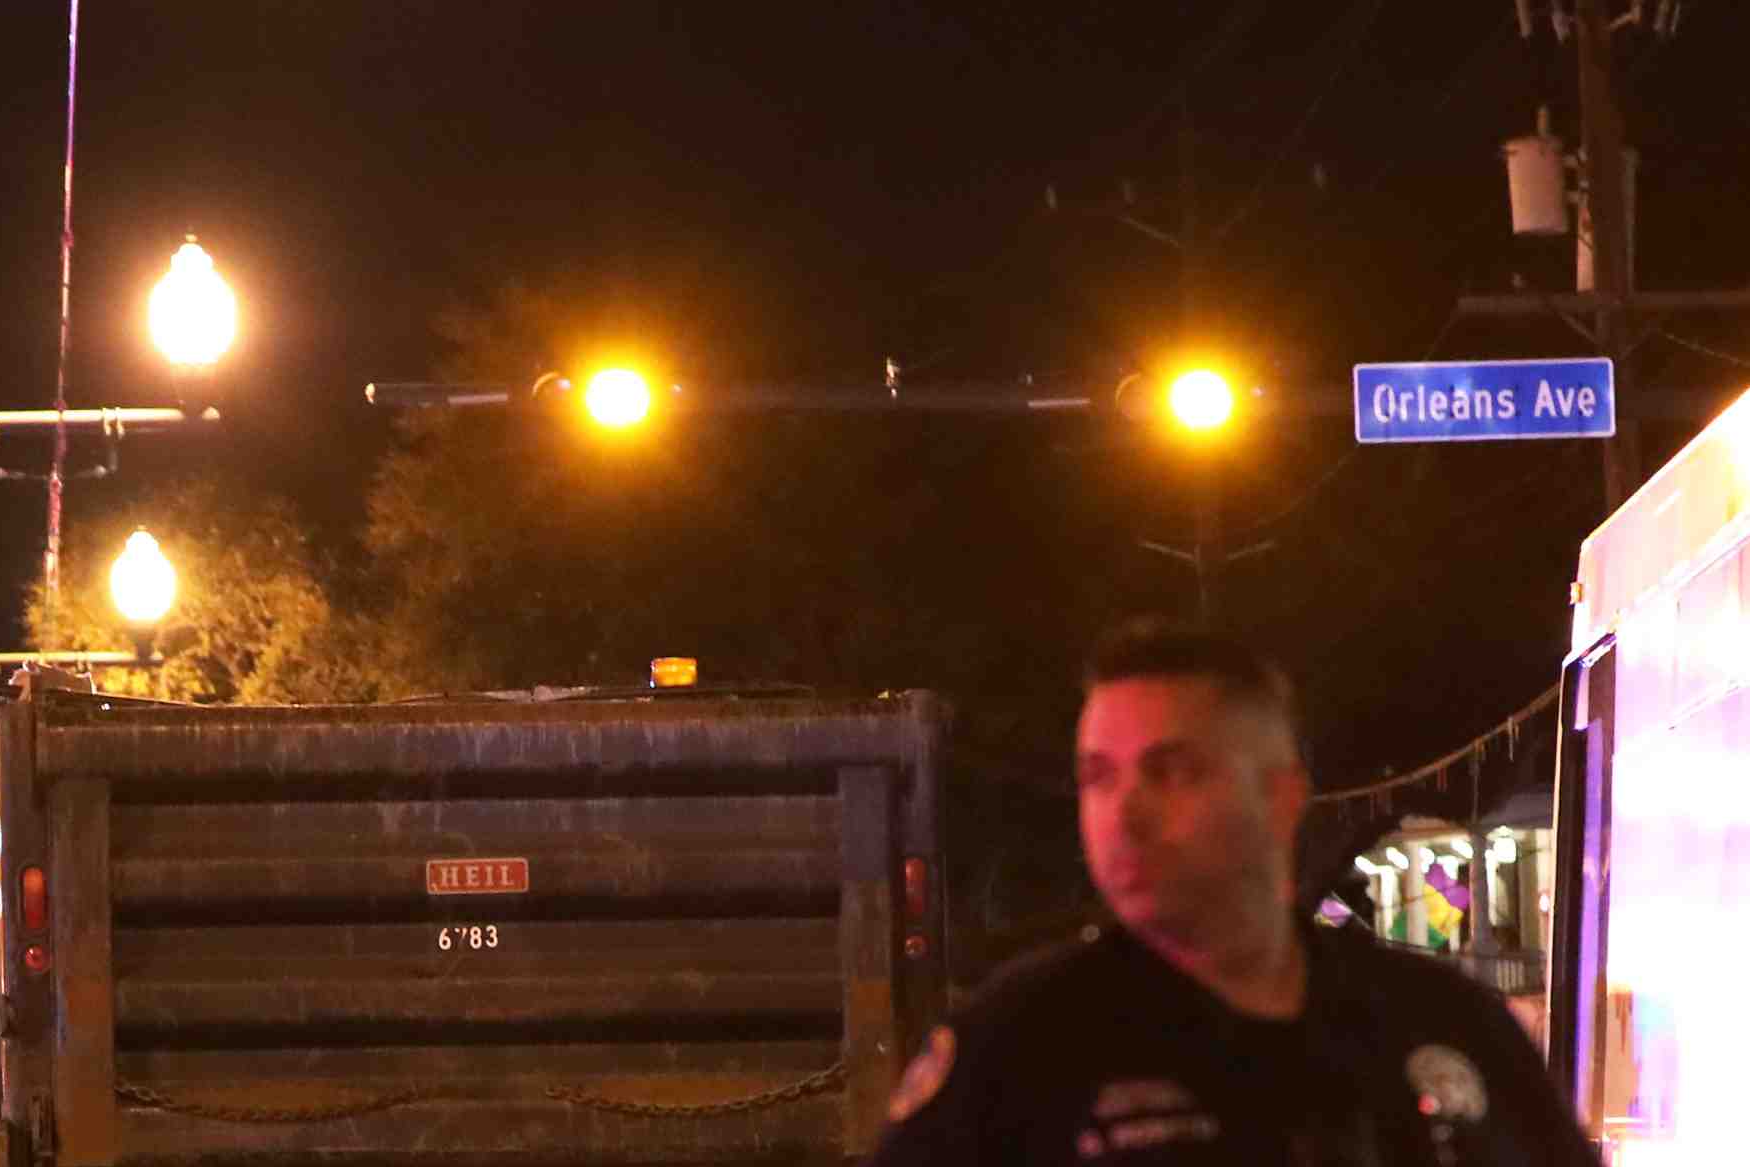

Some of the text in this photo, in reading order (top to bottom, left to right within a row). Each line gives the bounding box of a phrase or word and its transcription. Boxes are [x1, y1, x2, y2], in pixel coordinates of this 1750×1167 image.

[1373, 379, 1597, 423] Orleans Ave
[440, 865, 515, 887] HEIL
